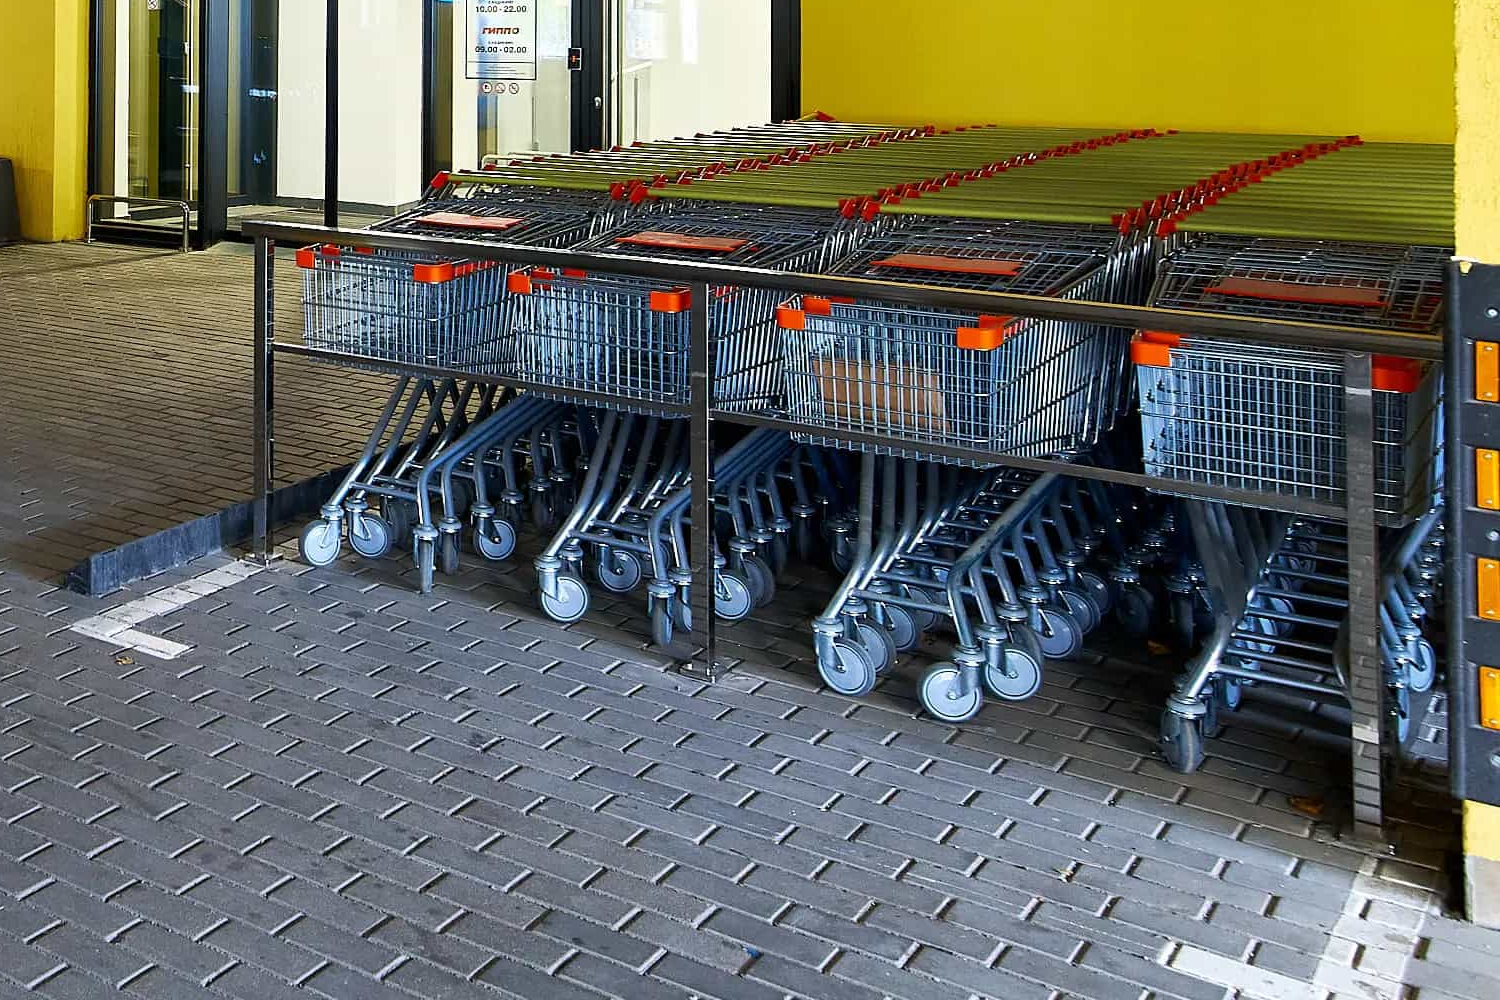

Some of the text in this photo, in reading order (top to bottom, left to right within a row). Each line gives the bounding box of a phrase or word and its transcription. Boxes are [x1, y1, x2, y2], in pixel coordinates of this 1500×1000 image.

[476, 5, 498, 13] 10.00
[503, 5, 527, 13] 22.00
[482, 27, 520, 35] ГИППО
